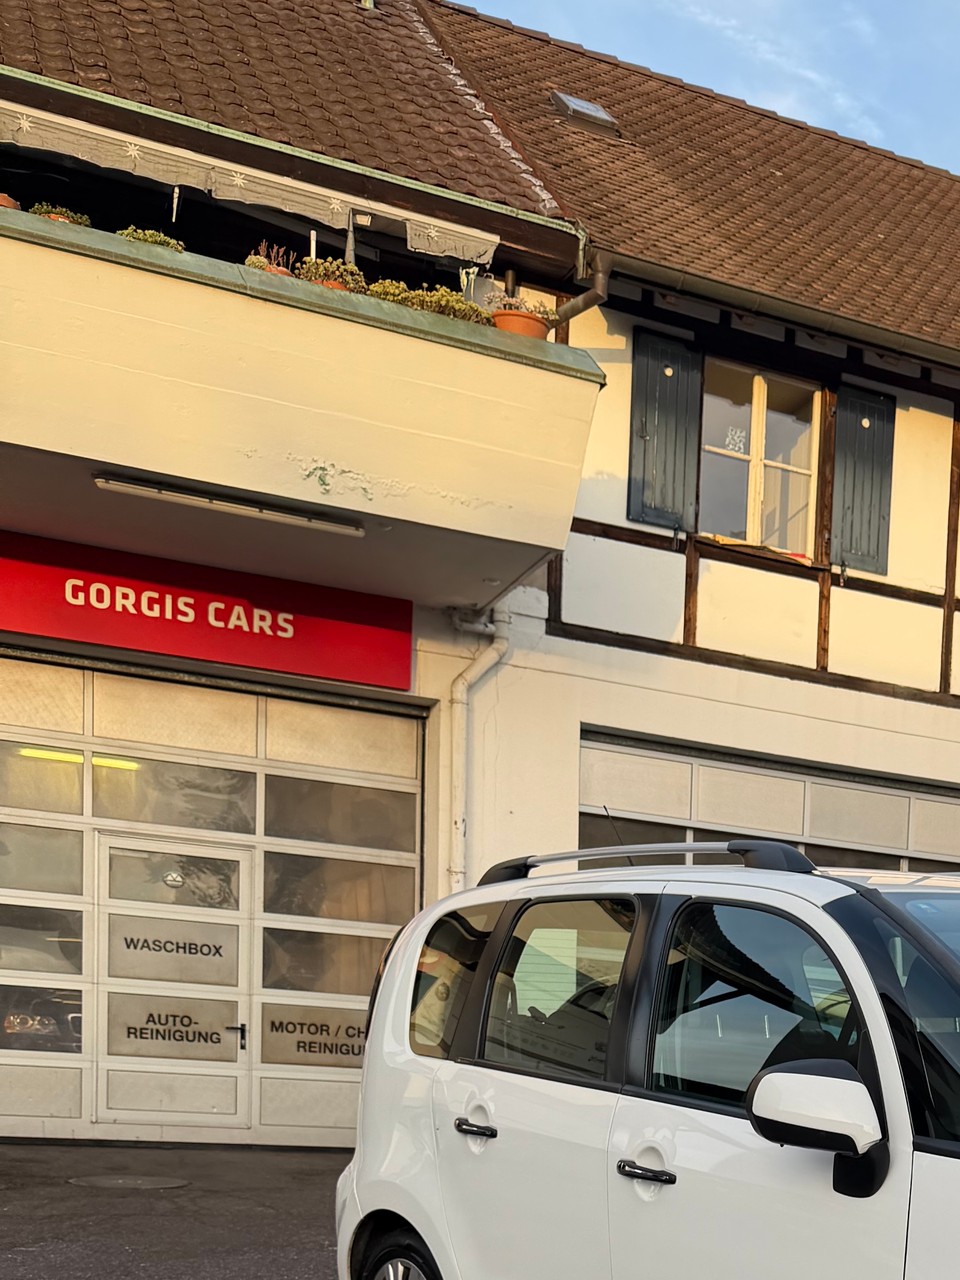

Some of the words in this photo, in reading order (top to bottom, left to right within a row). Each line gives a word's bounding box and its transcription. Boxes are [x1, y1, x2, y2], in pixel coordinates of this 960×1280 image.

[64, 578, 196, 623] GORGIS
[207, 601, 295, 639] CARS
[124, 937, 223, 957] WASCHBOX
[145, 1013, 199, 1028] AUTO-
[270, 1020, 331, 1036] MOTOR
[334, 1025, 341, 1037] /
[126, 1026, 222, 1044] REINIGUNG
[296, 1040, 366, 1056] REINIGU
